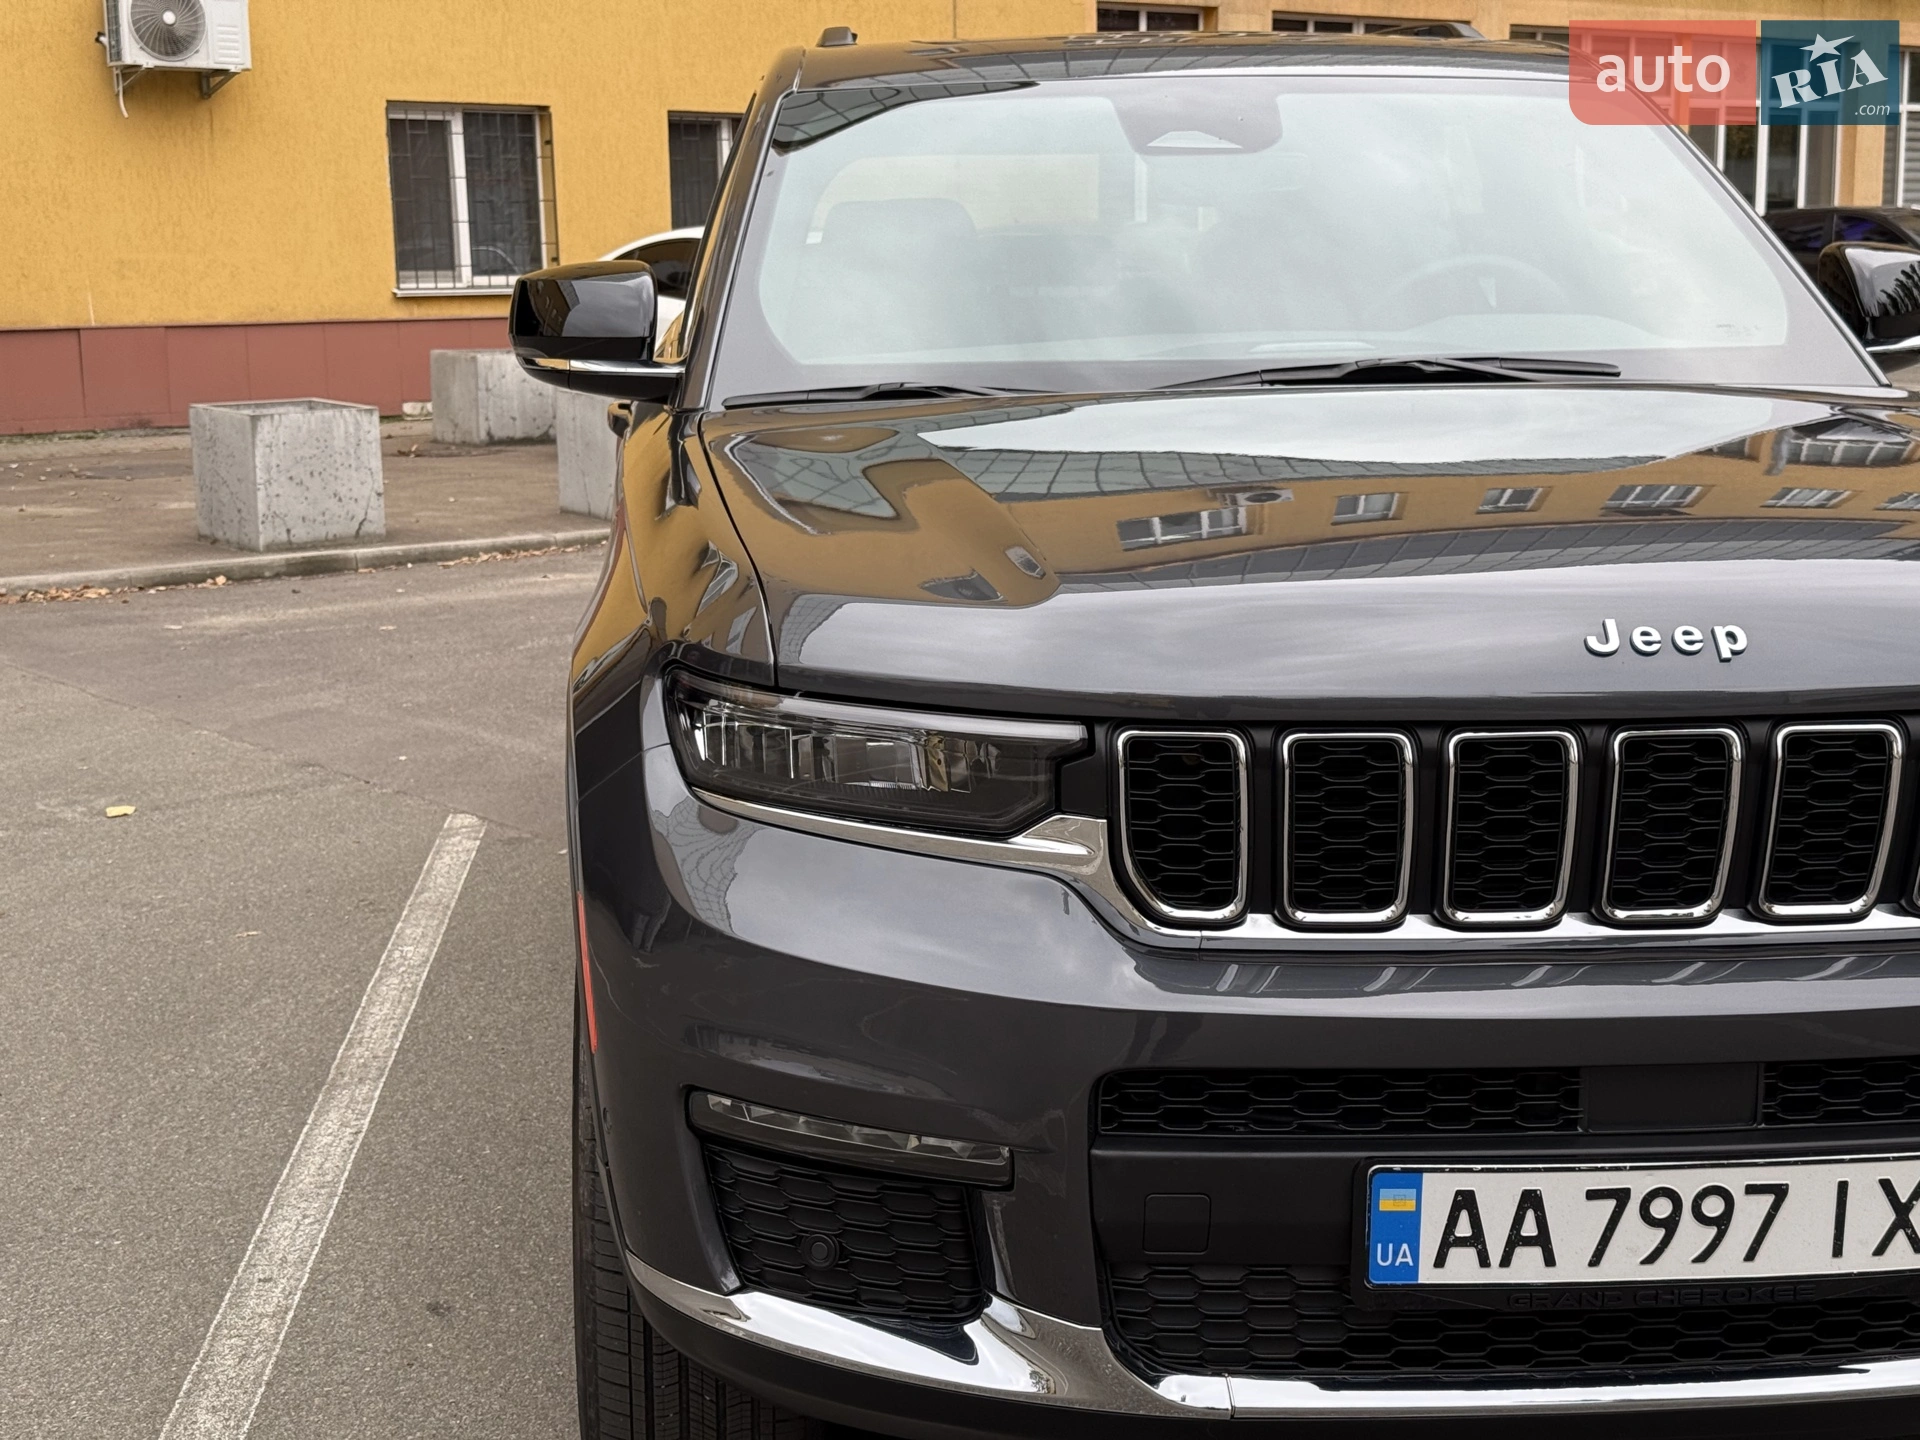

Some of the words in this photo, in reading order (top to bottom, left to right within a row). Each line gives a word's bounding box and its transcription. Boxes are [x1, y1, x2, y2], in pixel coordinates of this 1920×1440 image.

[1584, 618, 1748, 663] Jeep
[1432, 1188, 1557, 1268] AA
[1584, 1181, 1790, 1268] 7997
[1831, 1177, 1920, 1259] IX
[1375, 1242, 1414, 1267] UA
[1506, 1291, 1623, 1311] GRAND
[1635, 1284, 1817, 1307] CHEROKEE
